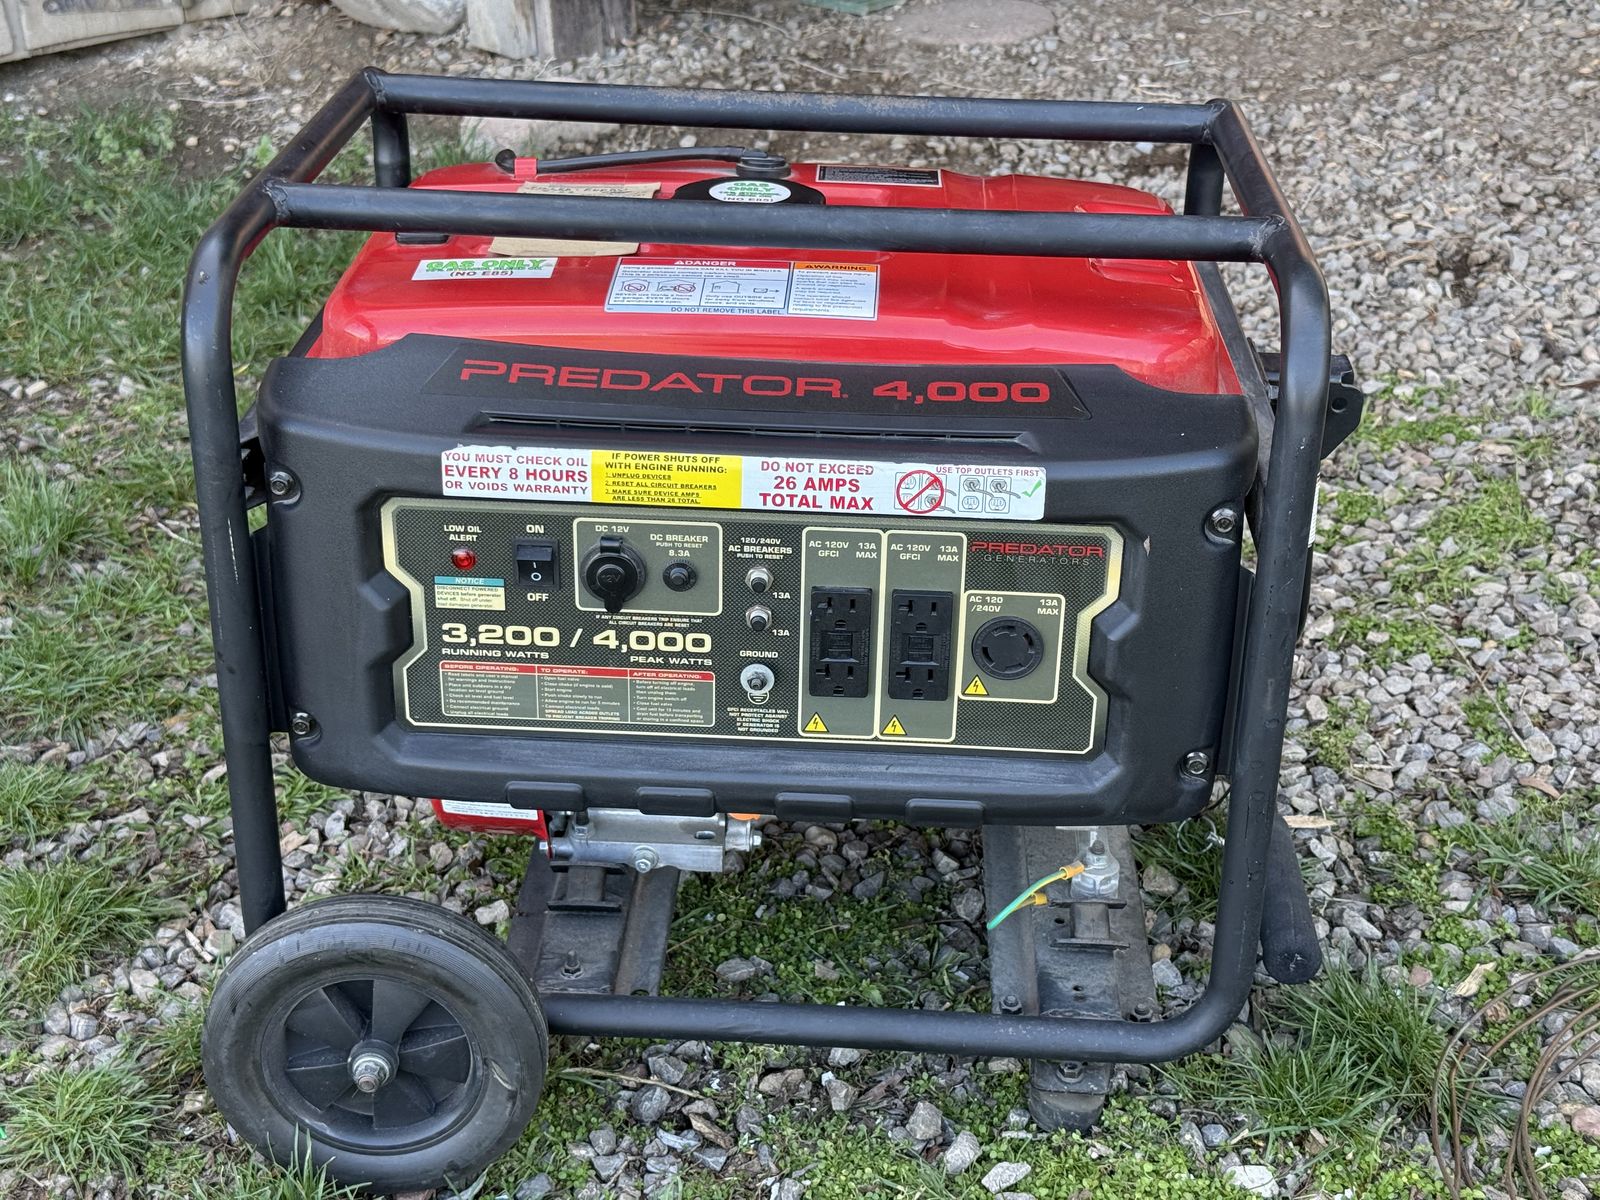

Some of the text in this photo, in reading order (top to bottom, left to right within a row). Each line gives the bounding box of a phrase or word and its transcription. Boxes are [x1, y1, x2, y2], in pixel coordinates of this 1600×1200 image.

[426, 260, 475, 271] GAS
[482, 259, 547, 270] ONLY
[460, 359, 1050, 405] PREDATOR 4,000
[444, 453, 588, 466] YOU MUST CHECK OIL
[664, 455, 697, 463] SHUTS
[605, 462, 727, 473] WITH ENGINE RUNNING:
[761, 461, 874, 475] DO NOT EXCEED
[936, 466, 1040, 477] USE TOP OUTLETS FIRST
[445, 465, 588, 483] EVERY 8 HOURS
[445, 481, 588, 495] OR VOIDS WARRANTY
[774, 476, 860, 492] 26 AMPS
[759, 492, 874, 511] TOTAL MAX
[526, 525, 544, 533] ON
[449, 534, 478, 542] ALERT
[744, 546, 792, 554] BREAKERS
[971, 542, 1103, 558] PREDATOR
[984, 555, 1089, 566] GENERATORS
[527, 593, 549, 601] OFF
[442, 623, 712, 653] 3,200 / 4,000
[442, 648, 549, 659] RUNNING WATTS
[631, 656, 664, 664] PEAK
